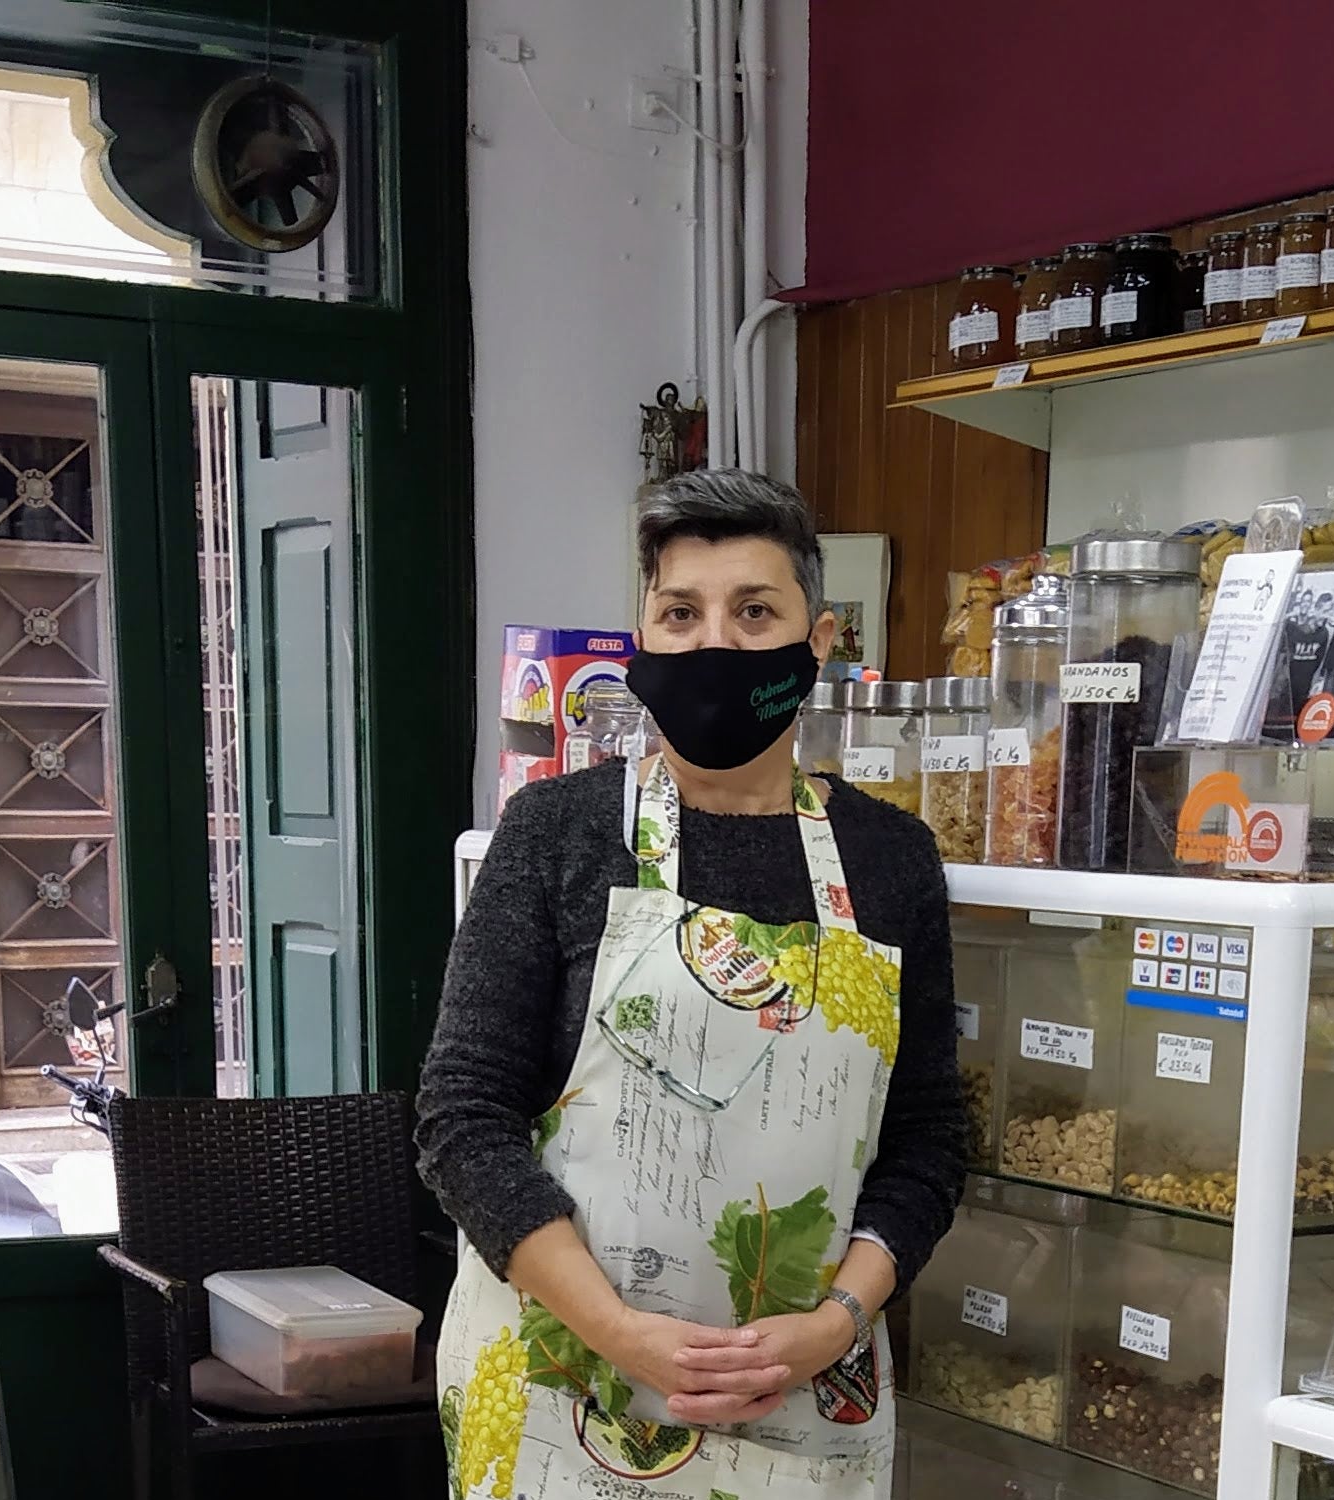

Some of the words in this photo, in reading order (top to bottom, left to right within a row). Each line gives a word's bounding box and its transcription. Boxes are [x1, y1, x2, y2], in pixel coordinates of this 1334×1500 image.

[587, 637, 625, 653] FIESTA
[1122, 685, 1138, 703] Kg
[1196, 942, 1215, 955] VISA
[1226, 943, 1245, 956] VISA
[763, 1049, 775, 1093] POSTALE
[760, 1099, 770, 1131] CARTE
